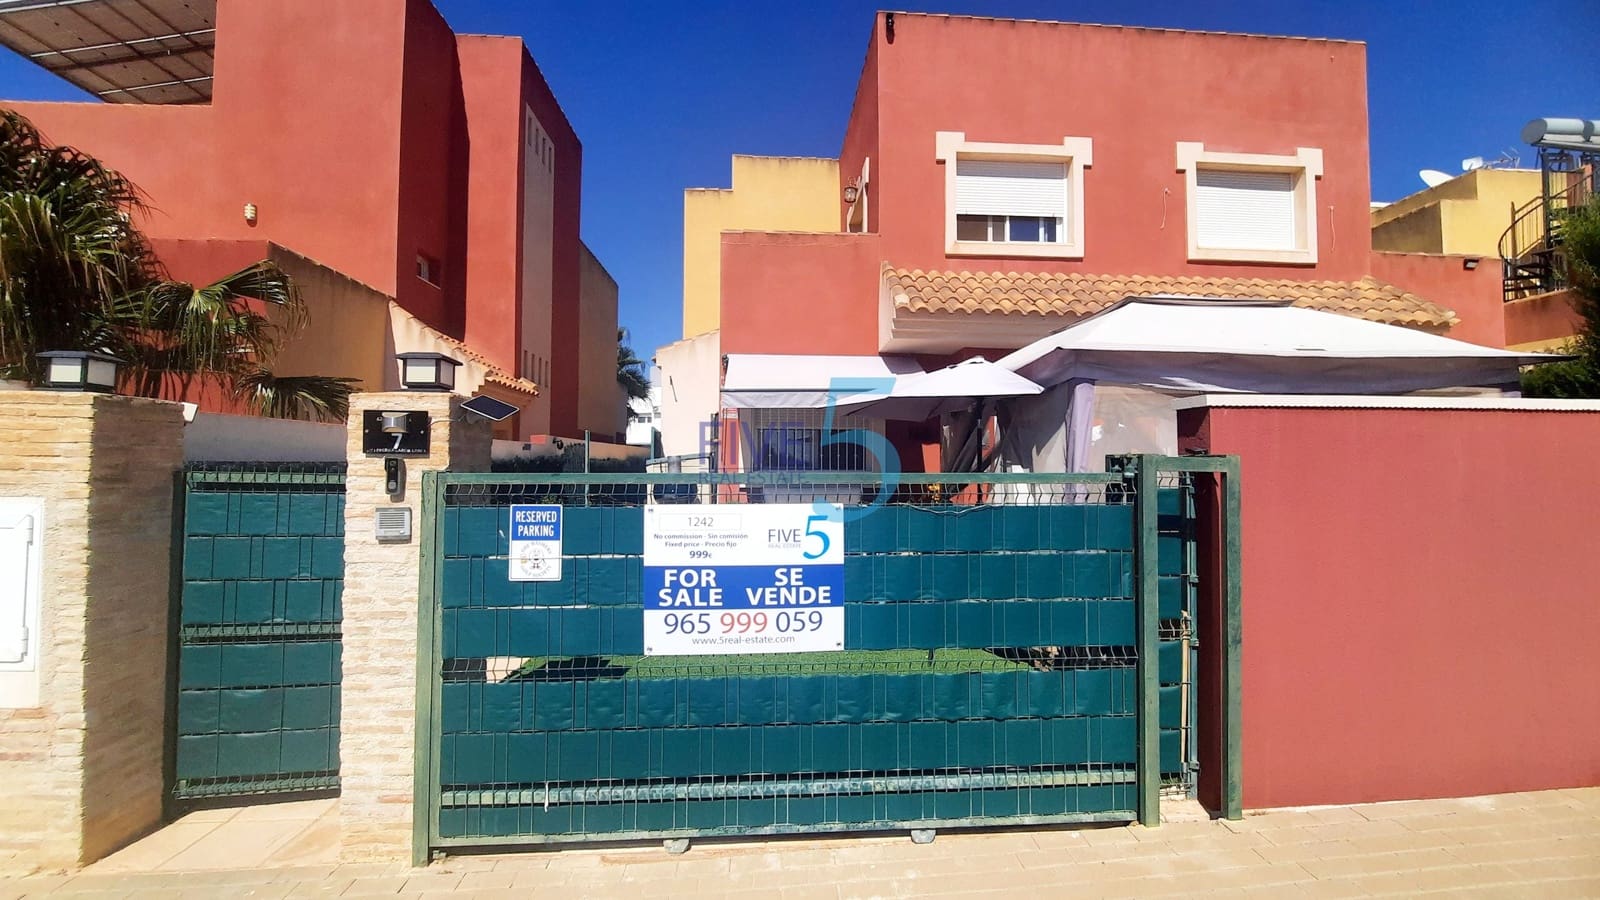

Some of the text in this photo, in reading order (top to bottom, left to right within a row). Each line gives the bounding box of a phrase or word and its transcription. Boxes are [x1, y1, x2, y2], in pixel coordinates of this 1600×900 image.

[391, 433, 403, 450] 7
[515, 510, 558, 523] RESERVED
[688, 517, 714, 527] 1242
[517, 525, 555, 537] PARKING
[768, 528, 801, 543] FIVE
[803, 515, 830, 560] 5
[689, 550, 712, 559] 999€
[664, 569, 717, 588] FOR
[774, 567, 803, 586] SE
[658, 588, 723, 607] SALE
[745, 585, 831, 606] VENDE
[664, 610, 823, 635] 965 999 059
[692, 635, 795, 646] www.5real-estate.com
